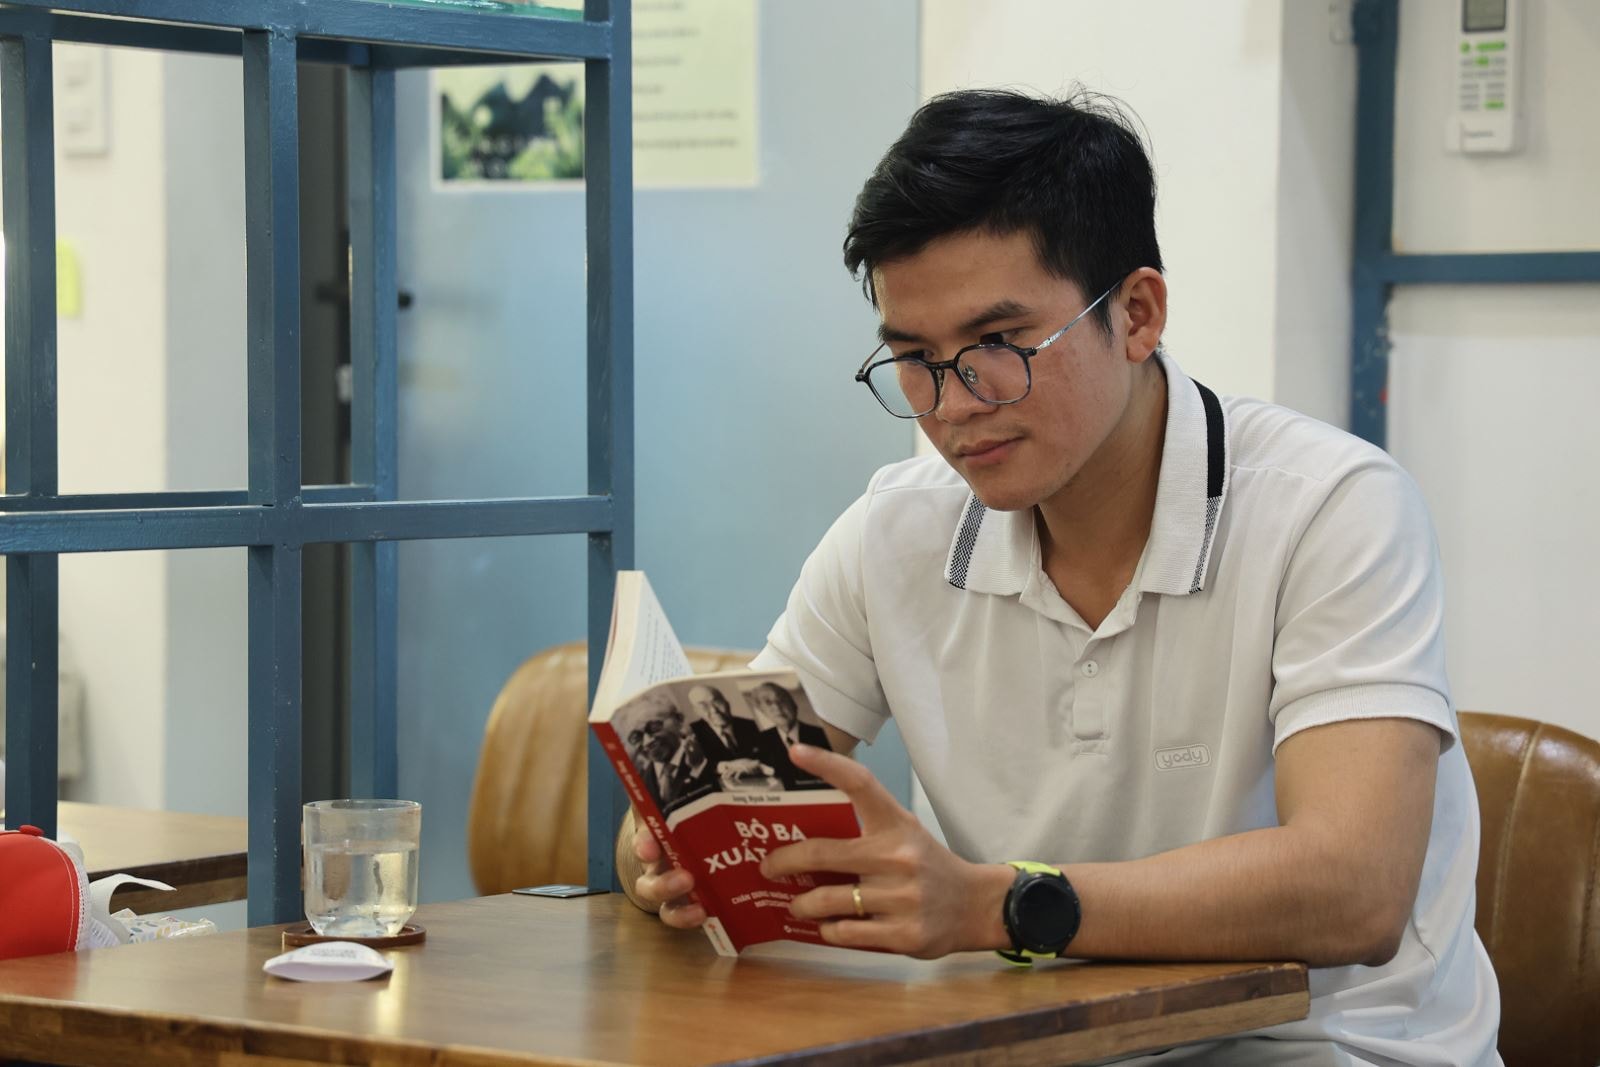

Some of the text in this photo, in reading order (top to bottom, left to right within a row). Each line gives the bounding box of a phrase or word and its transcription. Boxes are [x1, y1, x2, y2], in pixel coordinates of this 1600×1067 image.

[1161, 747, 1204, 768] yody
[734, 817, 808, 845] BỘ BA
